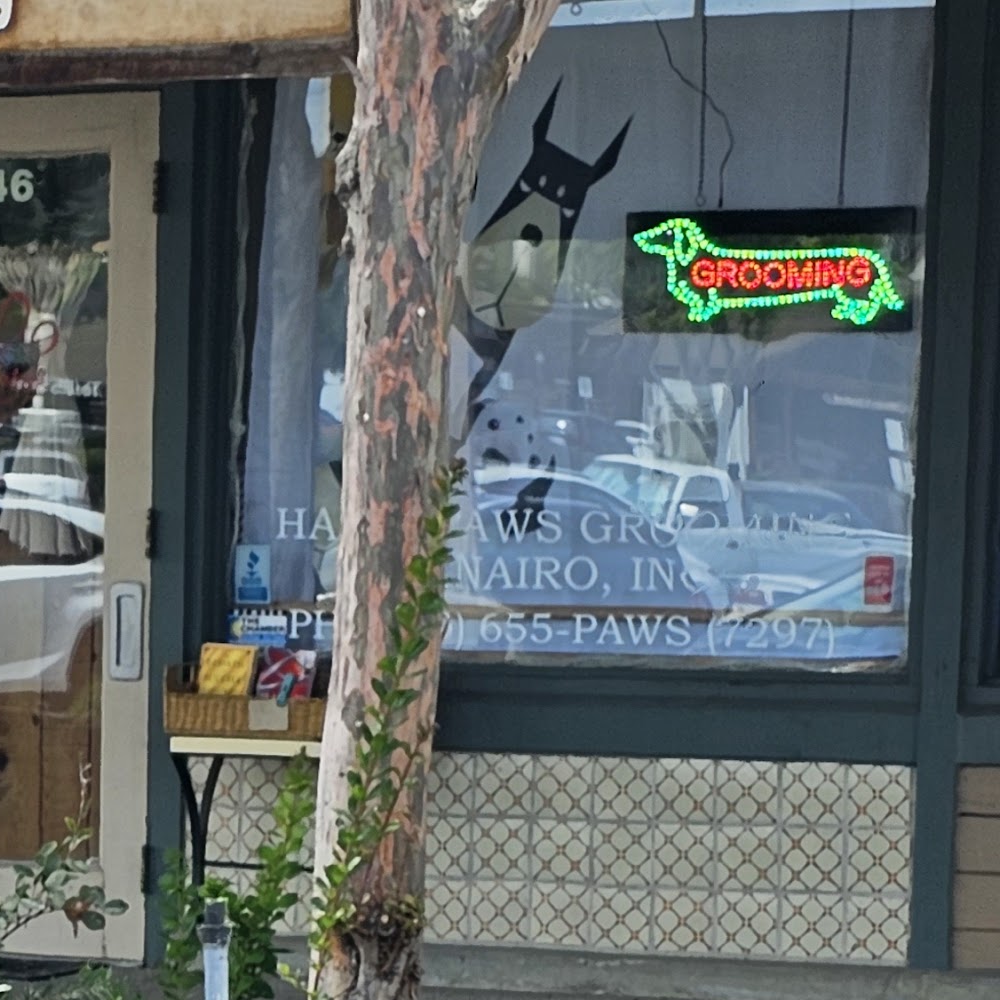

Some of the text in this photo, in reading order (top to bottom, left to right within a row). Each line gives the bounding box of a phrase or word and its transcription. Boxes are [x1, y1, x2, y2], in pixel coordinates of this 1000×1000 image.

[690, 256, 872, 289] GROOMING
[460, 508, 563, 545] AWS
[480, 611, 692, 647] 655-PAWS
[708, 616, 835, 656] (7297)
